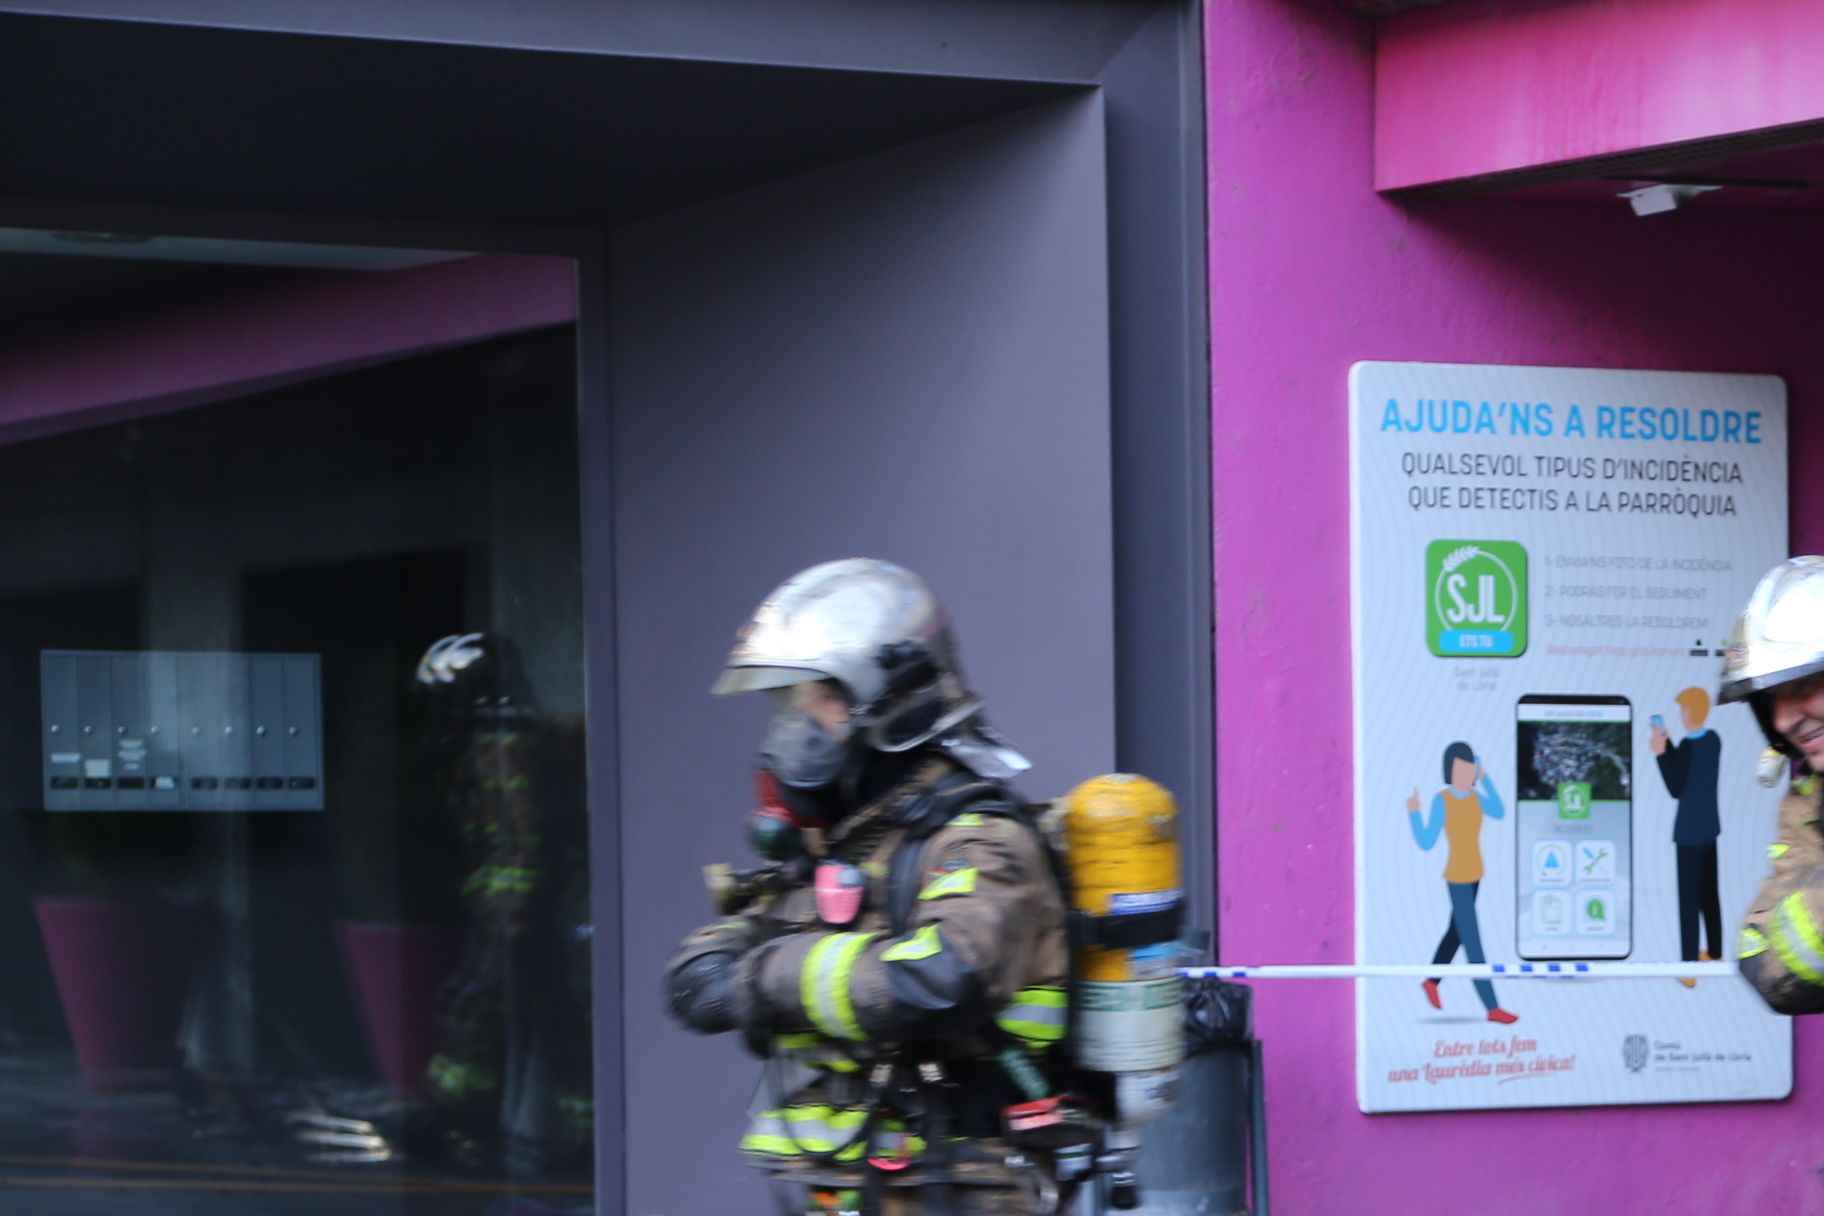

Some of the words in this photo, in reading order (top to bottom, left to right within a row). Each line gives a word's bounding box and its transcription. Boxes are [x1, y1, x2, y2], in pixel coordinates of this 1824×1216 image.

[1380, 397, 1554, 438] AJUDA'NS
[1563, 404, 1587, 438] A
[1598, 404, 1762, 445] RESOLDRE
[1402, 452, 1528, 478] QUALSEVOL
[1534, 455, 1596, 480] TIPUS
[1603, 453, 1742, 484] D'INCIDÈNCIA
[1408, 486, 1452, 509] QUE
[1458, 487, 1558, 512] DETECTIS
[1564, 490, 1580, 511] A
[1586, 490, 1611, 513] LA
[1618, 487, 1738, 517] PARRÒQUIA
[1446, 573, 1505, 623] SJL
[1433, 1039, 1474, 1058] Entre
[1387, 1068, 1419, 1083] una
